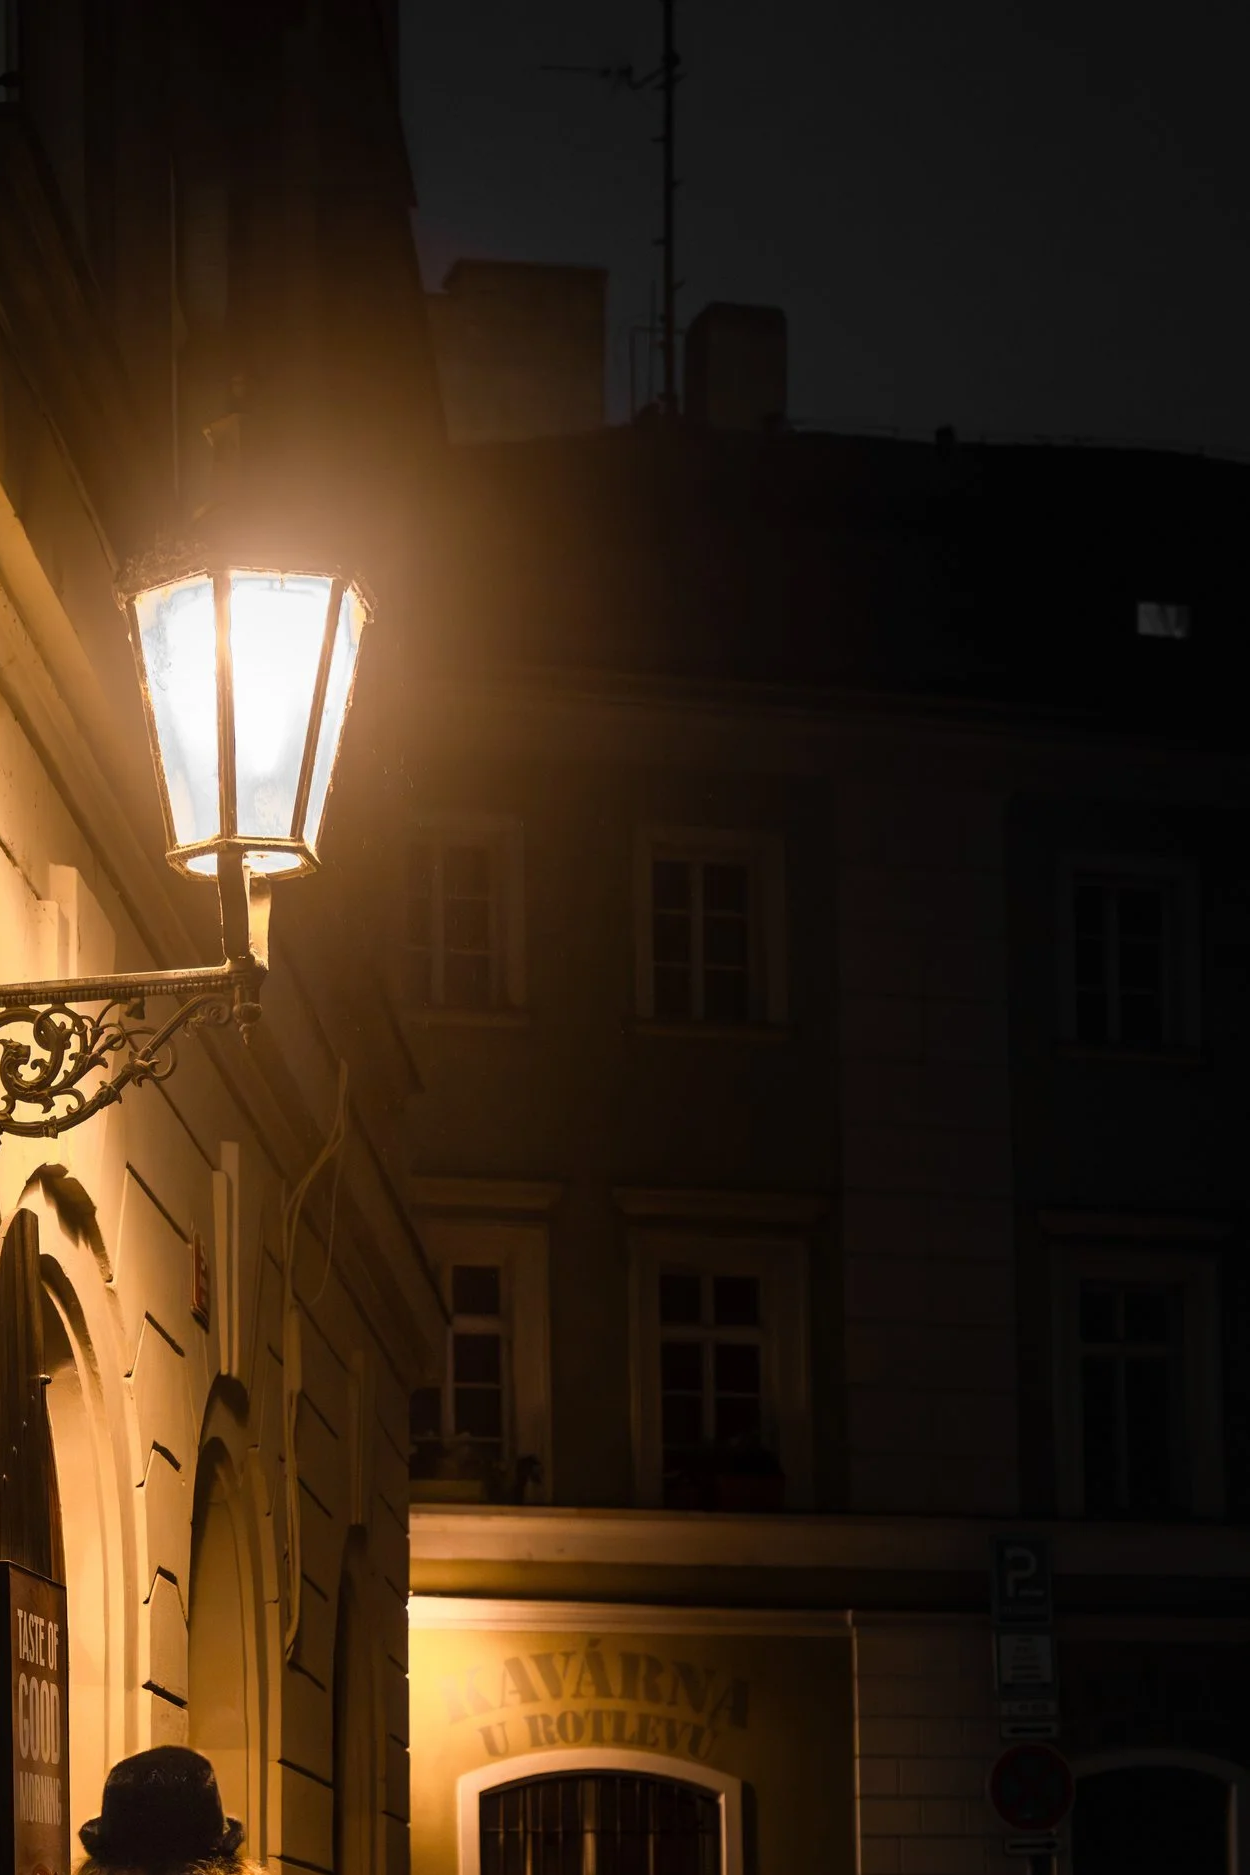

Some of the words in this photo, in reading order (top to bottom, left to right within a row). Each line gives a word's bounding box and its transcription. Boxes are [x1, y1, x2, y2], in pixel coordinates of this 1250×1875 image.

[16, 1607, 45, 1667] TASTE
[47, 1619, 60, 1671] OF
[18, 1671, 61, 1766] GOOD
[477, 1721, 510, 1757] U
[19, 1770, 62, 1826] MORNING
